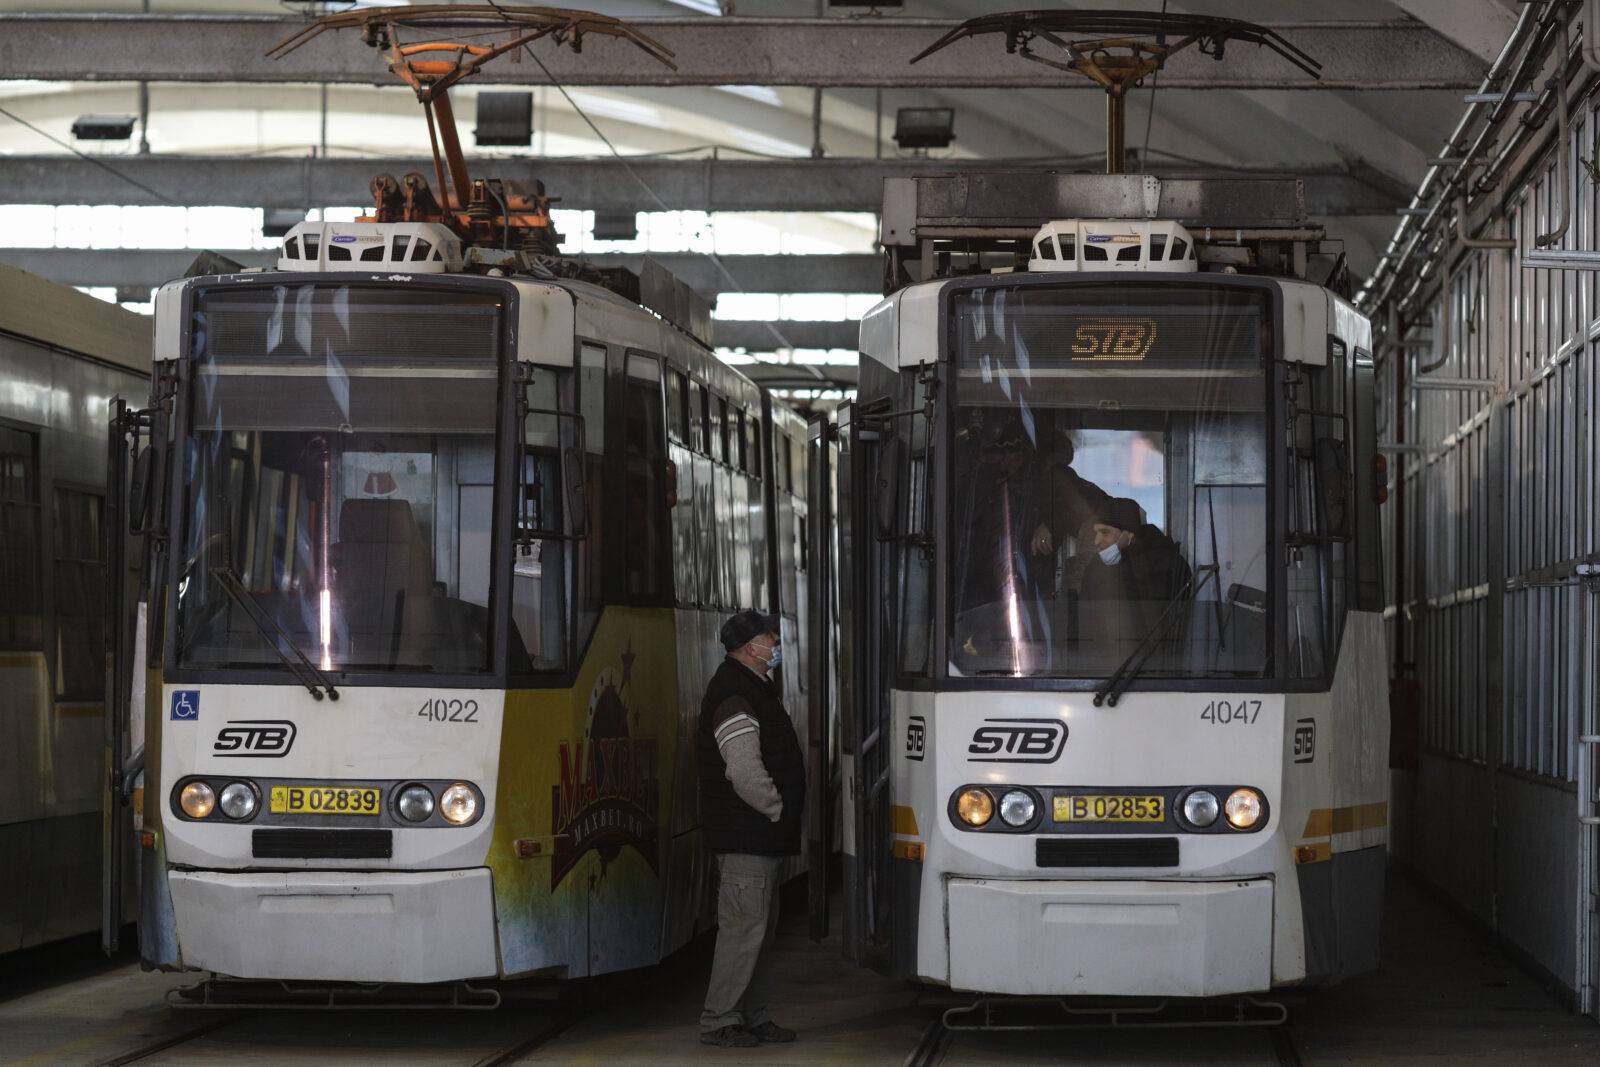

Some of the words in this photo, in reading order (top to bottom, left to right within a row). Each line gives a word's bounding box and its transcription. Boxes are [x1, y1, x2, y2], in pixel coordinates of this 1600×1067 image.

[1071, 325, 1146, 353] STB
[418, 699, 479, 723] 4022
[1200, 700, 1262, 725] 4047
[213, 727, 288, 750] STB
[906, 724, 924, 752] STB
[967, 726, 1058, 754] STB
[1293, 726, 1314, 755] STB
[557, 737, 657, 833] MAXBET
[289, 789, 304, 810] B
[309, 789, 377, 812] 02839
[1072, 798, 1088, 819] B
[1094, 796, 1161, 819] 02853
[574, 808, 643, 846] MAXBET.RO
